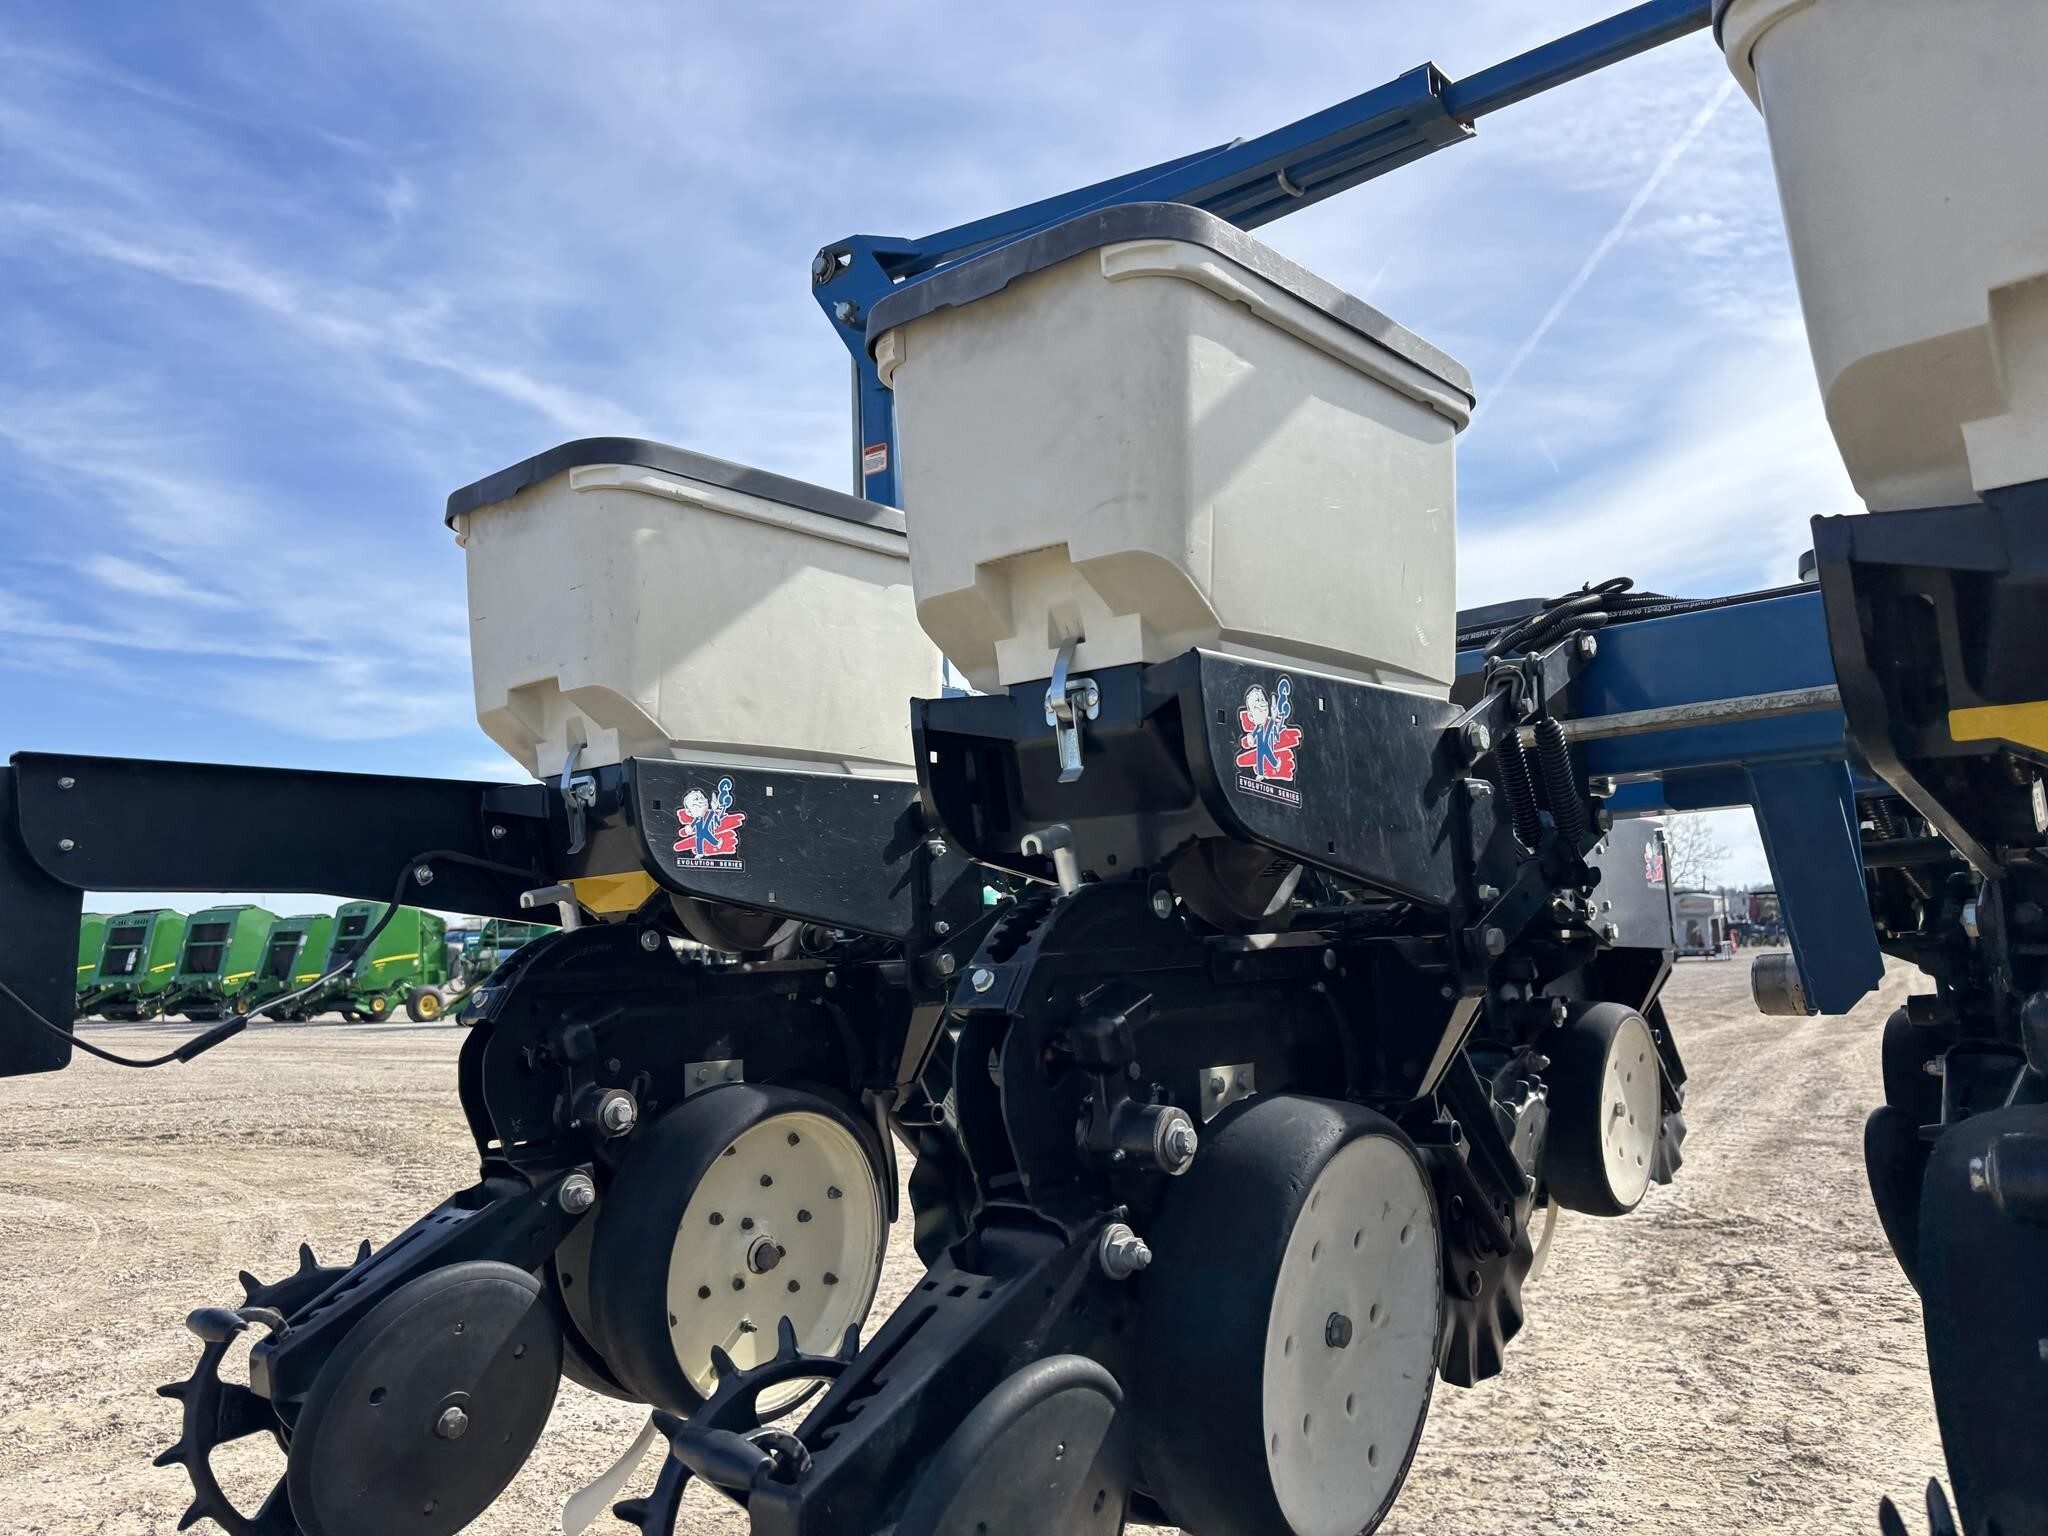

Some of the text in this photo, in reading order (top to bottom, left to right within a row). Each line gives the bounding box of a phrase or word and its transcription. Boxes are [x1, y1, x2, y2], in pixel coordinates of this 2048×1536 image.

[1239, 778, 1300, 801] EVOLUTION SERIES
[719, 860, 742, 868] SERIES
